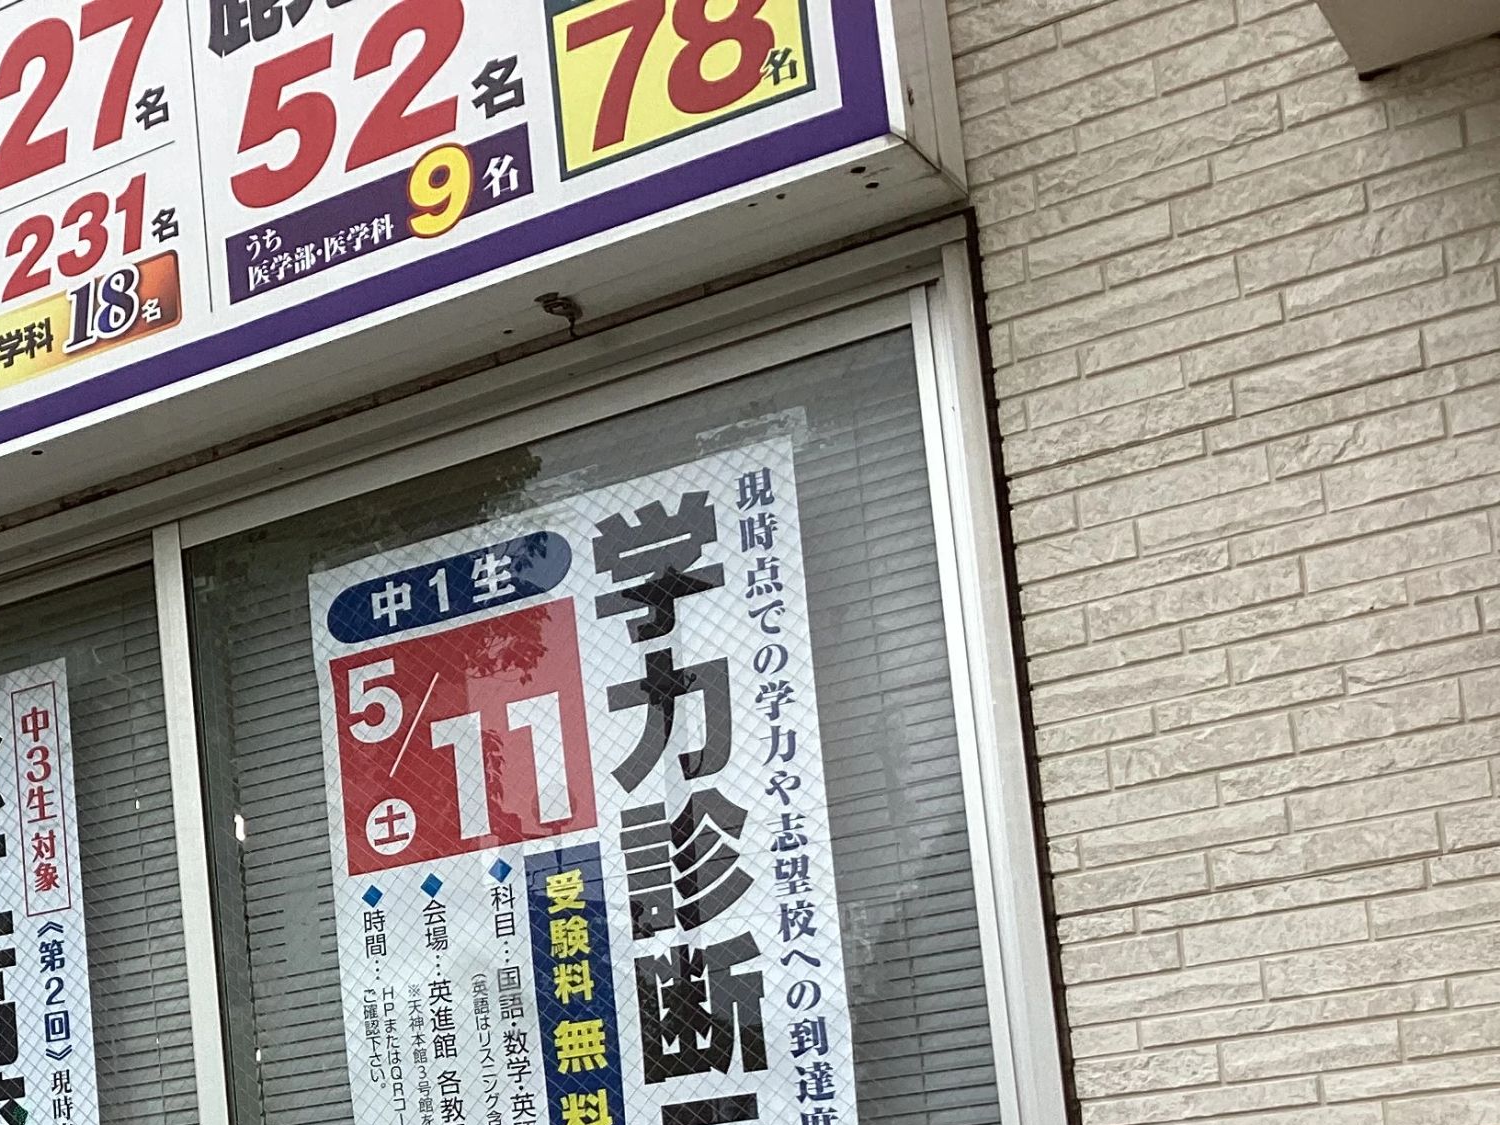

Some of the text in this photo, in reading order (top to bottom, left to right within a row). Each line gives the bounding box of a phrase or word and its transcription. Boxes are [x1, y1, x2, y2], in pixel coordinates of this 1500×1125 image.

[244, 226, 283, 262] うち
[247, 213, 395, 292] 医学部・医学科
[370, 549, 518, 630] 中1生
